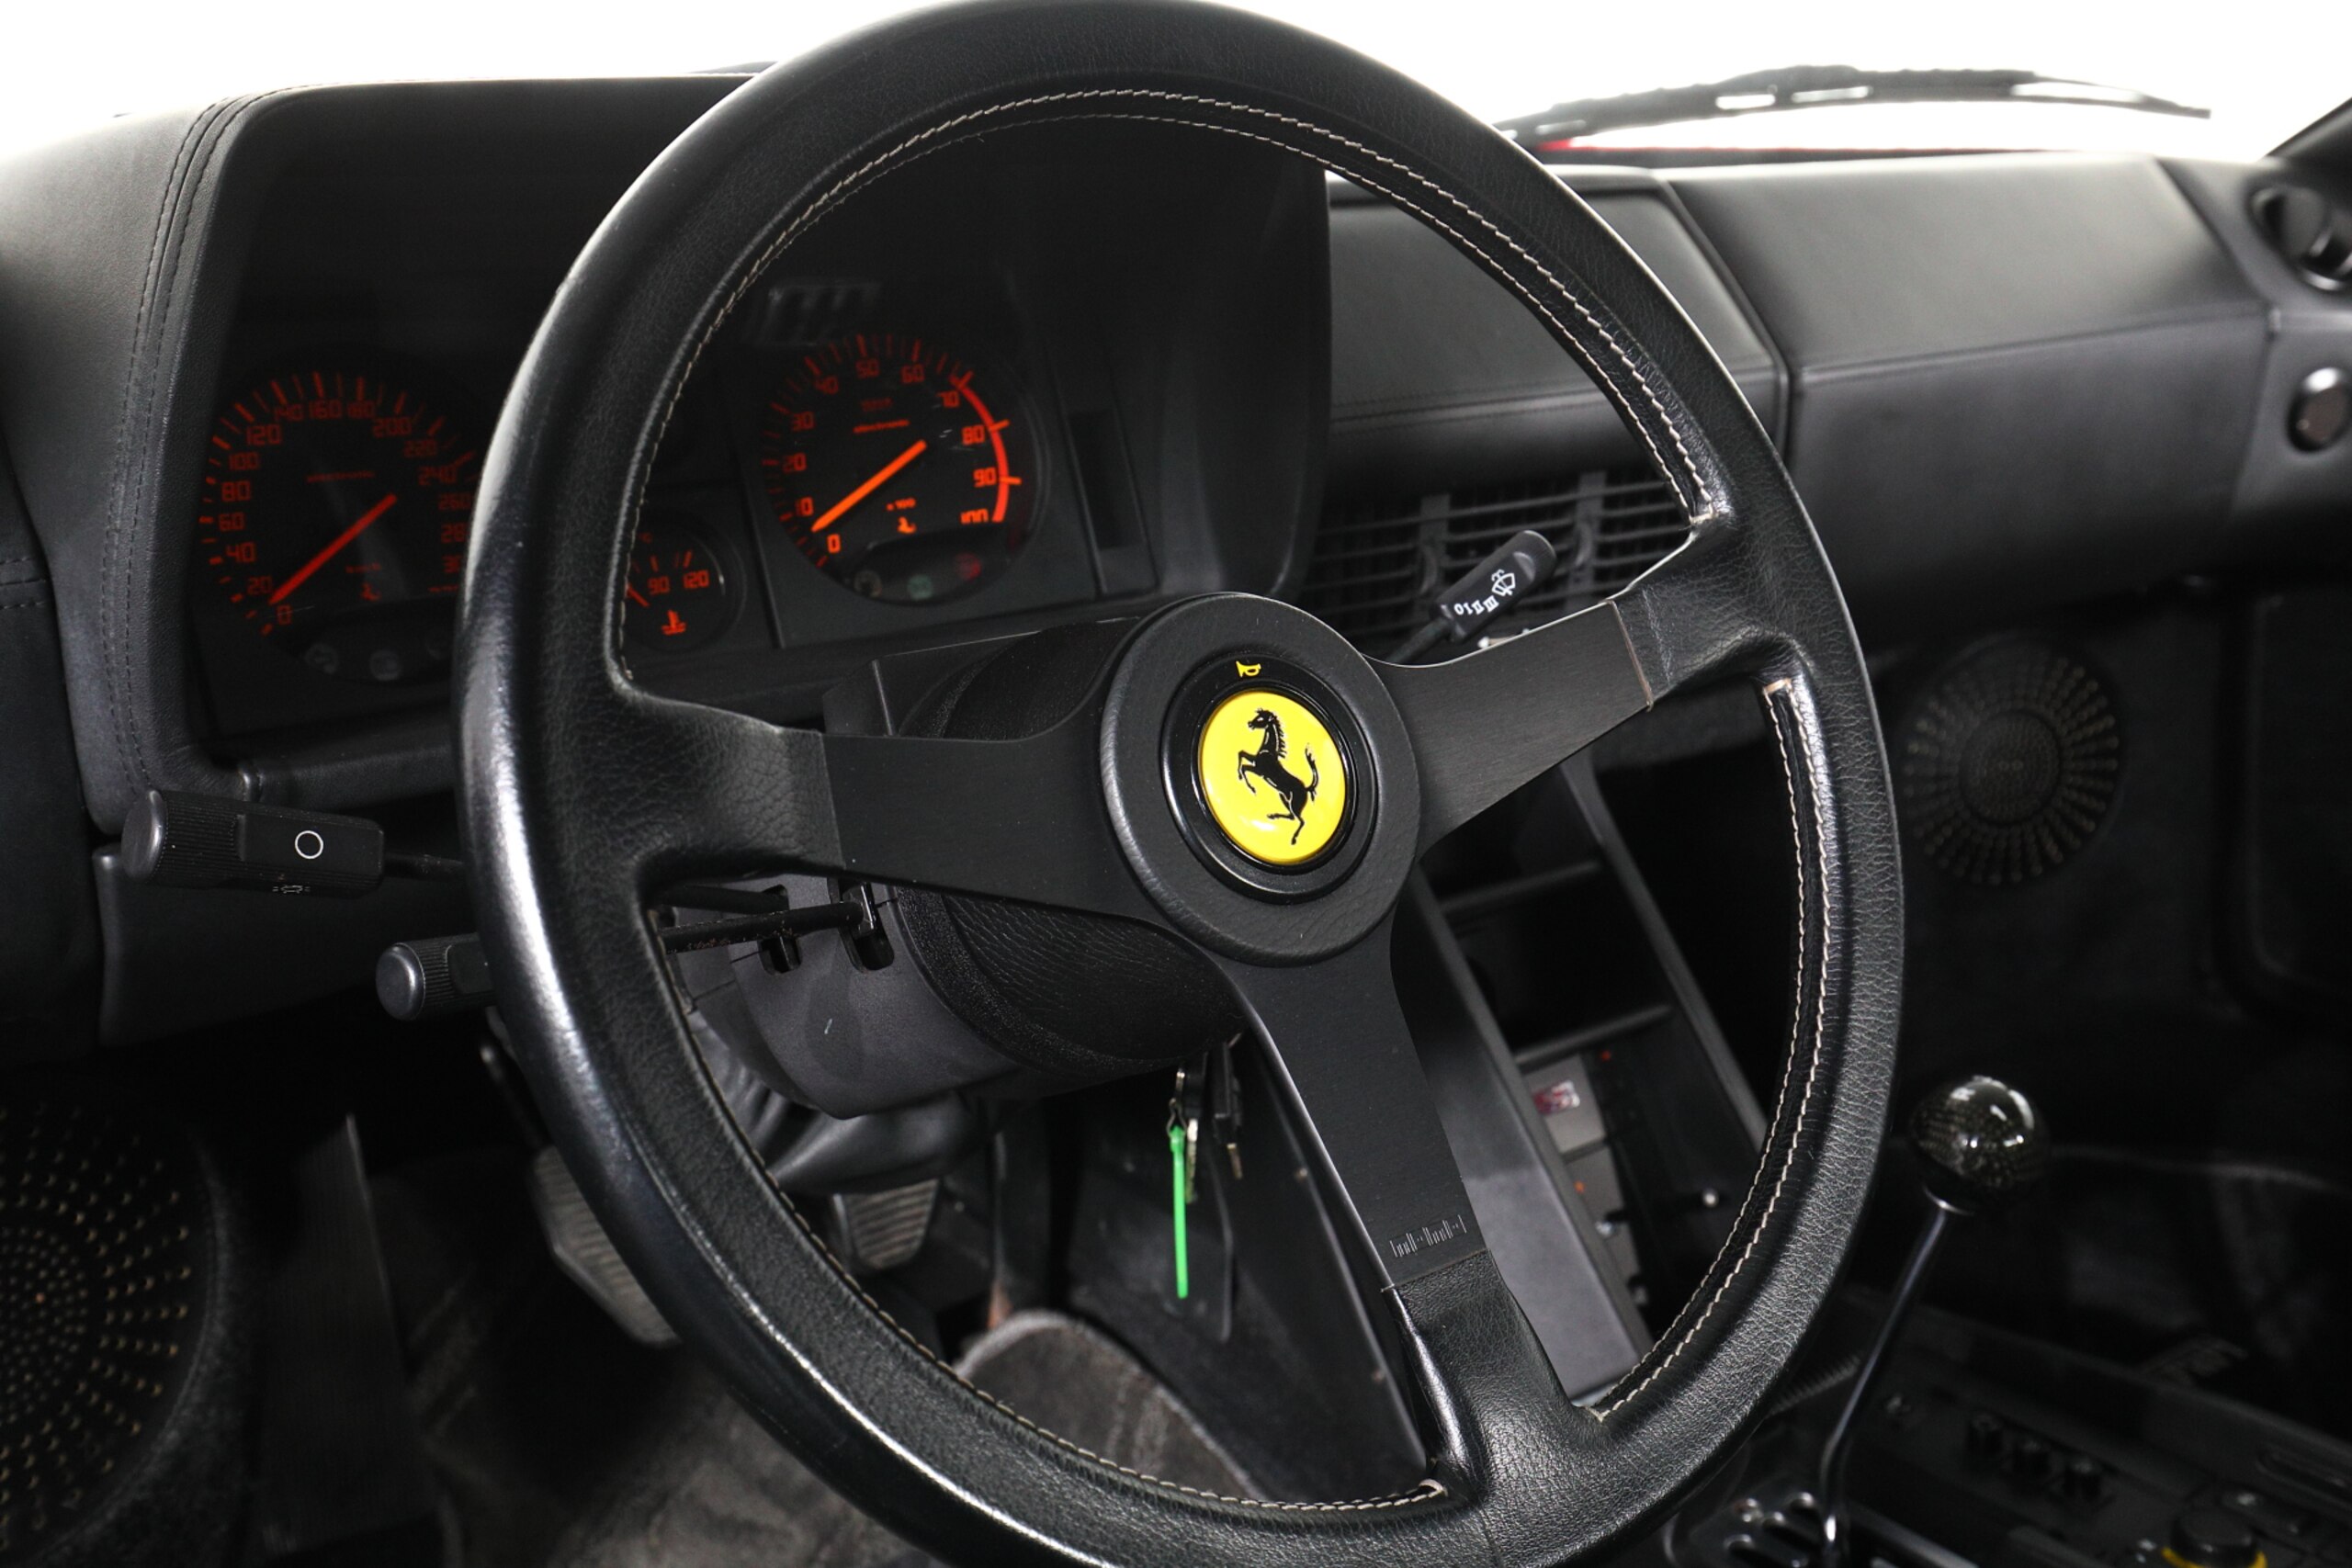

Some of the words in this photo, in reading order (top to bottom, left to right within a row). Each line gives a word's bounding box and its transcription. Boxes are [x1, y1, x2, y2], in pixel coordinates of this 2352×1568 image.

[900, 364, 924, 383] 60
[245, 423, 282, 446] 120
[961, 424, 986, 445] 80
[229, 451, 260, 471] 100
[973, 467, 996, 488] 90
[220, 479, 251, 502] 80
[218, 511, 245, 532] 60
[226, 541, 255, 563] 40
[827, 533, 841, 553] 0
[246, 575, 273, 595] 20
[277, 604, 291, 625] 0
